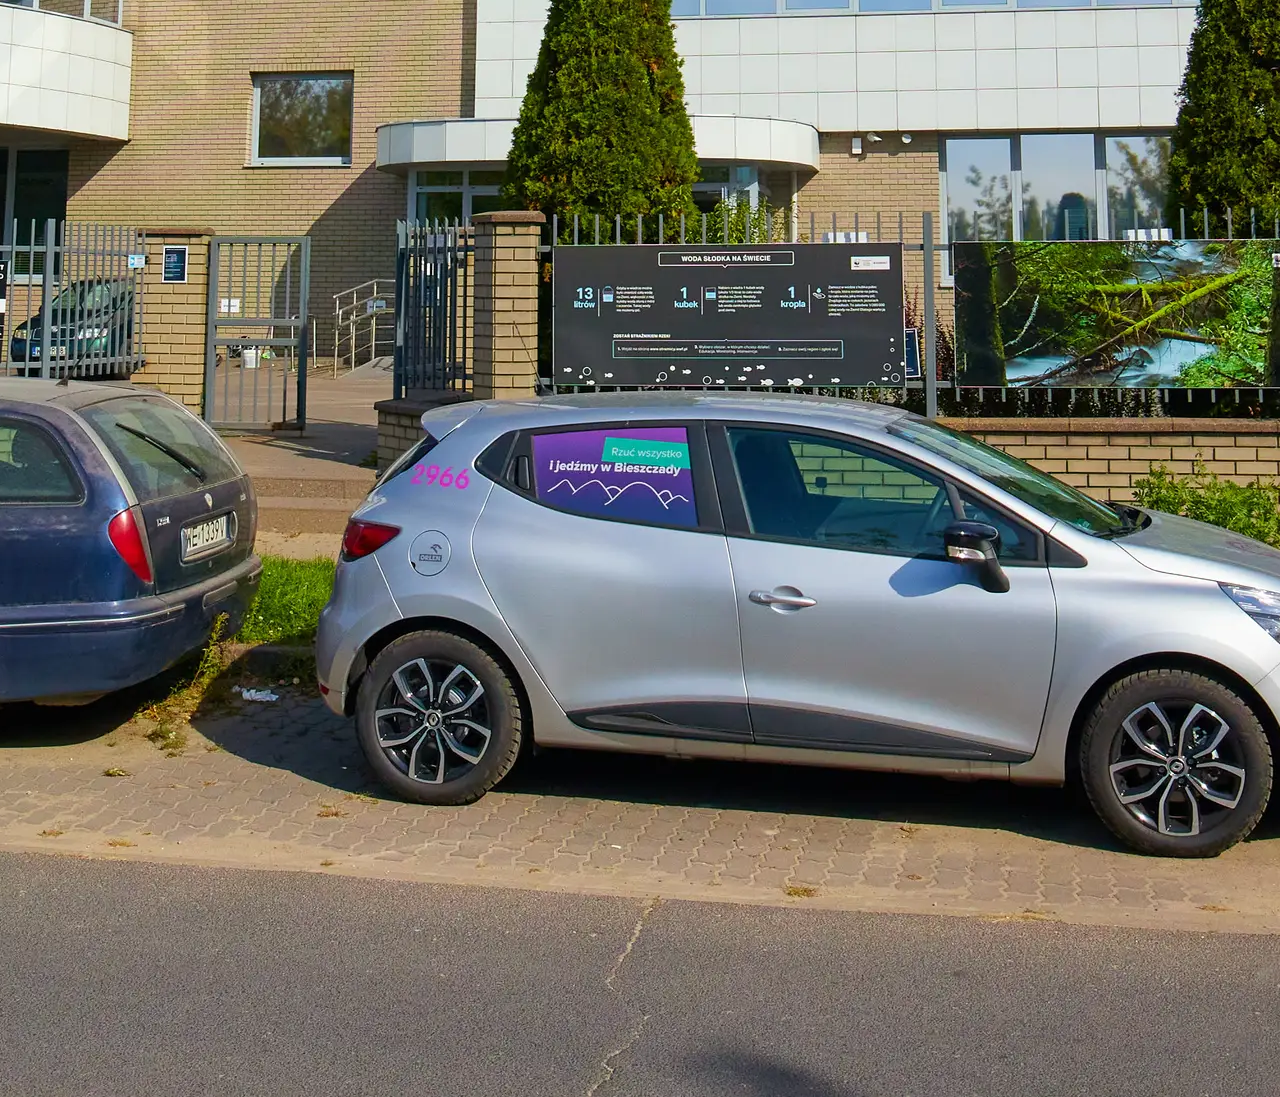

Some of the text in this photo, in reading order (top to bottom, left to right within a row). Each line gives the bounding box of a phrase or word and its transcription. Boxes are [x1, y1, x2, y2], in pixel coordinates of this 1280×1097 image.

[576, 287, 593, 299] 13
[680, 287, 687, 299] 1
[788, 286, 795, 298] 1
[574, 300, 595, 308] litrów
[780, 300, 806, 309] kropla
[611, 447, 682, 459] Rzuć wszystko
[549, 460, 681, 476] i jedźmy w Bieszczady
[410, 463, 470, 490] 2966
